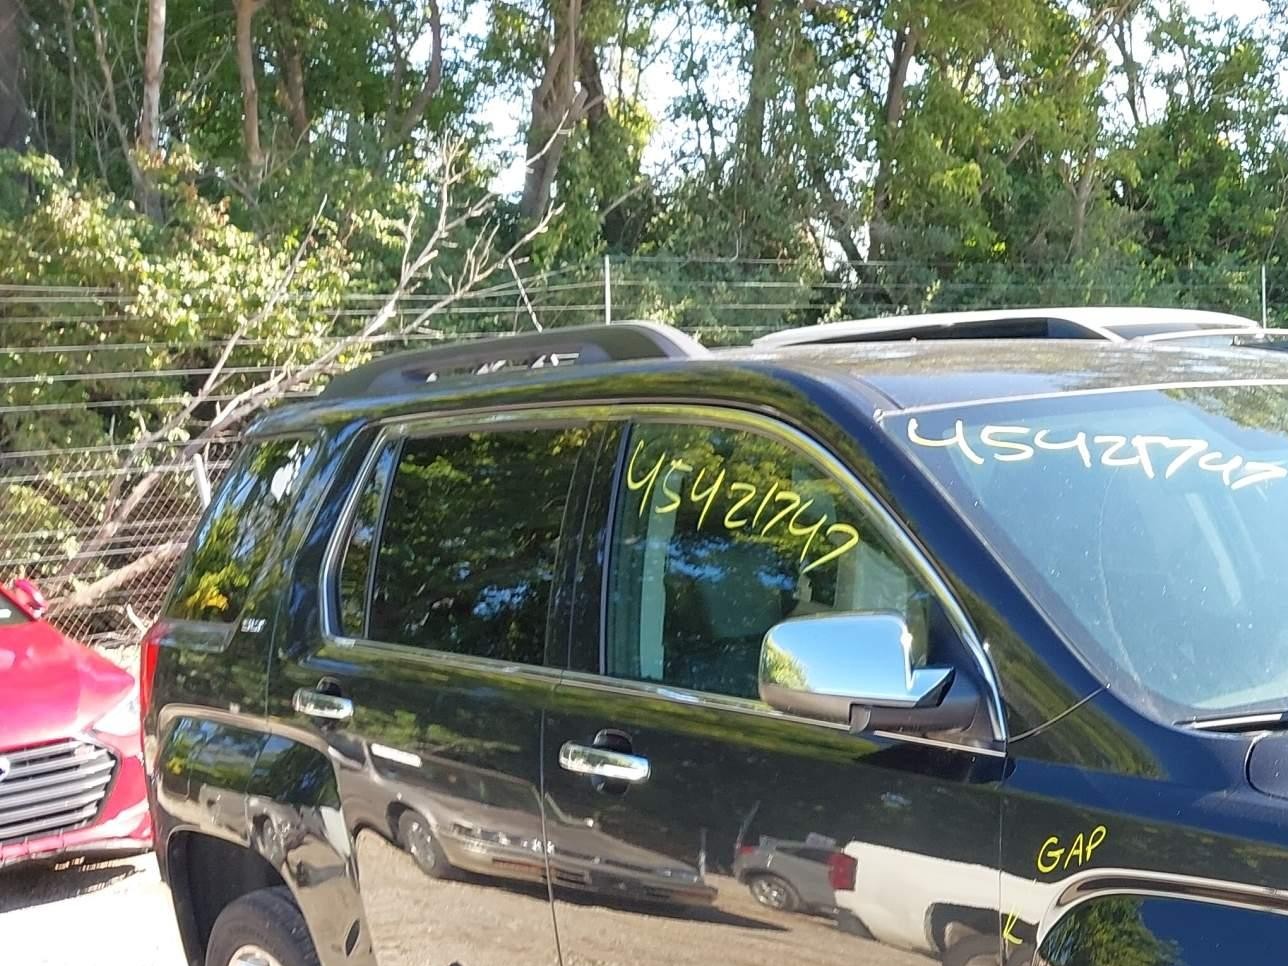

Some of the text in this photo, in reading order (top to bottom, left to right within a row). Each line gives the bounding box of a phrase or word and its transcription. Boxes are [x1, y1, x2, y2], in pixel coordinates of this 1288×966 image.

[908, 417, 1288, 490] 45421747
[627, 440, 860, 574] 45421747
[1037, 825, 1107, 873] GAP
